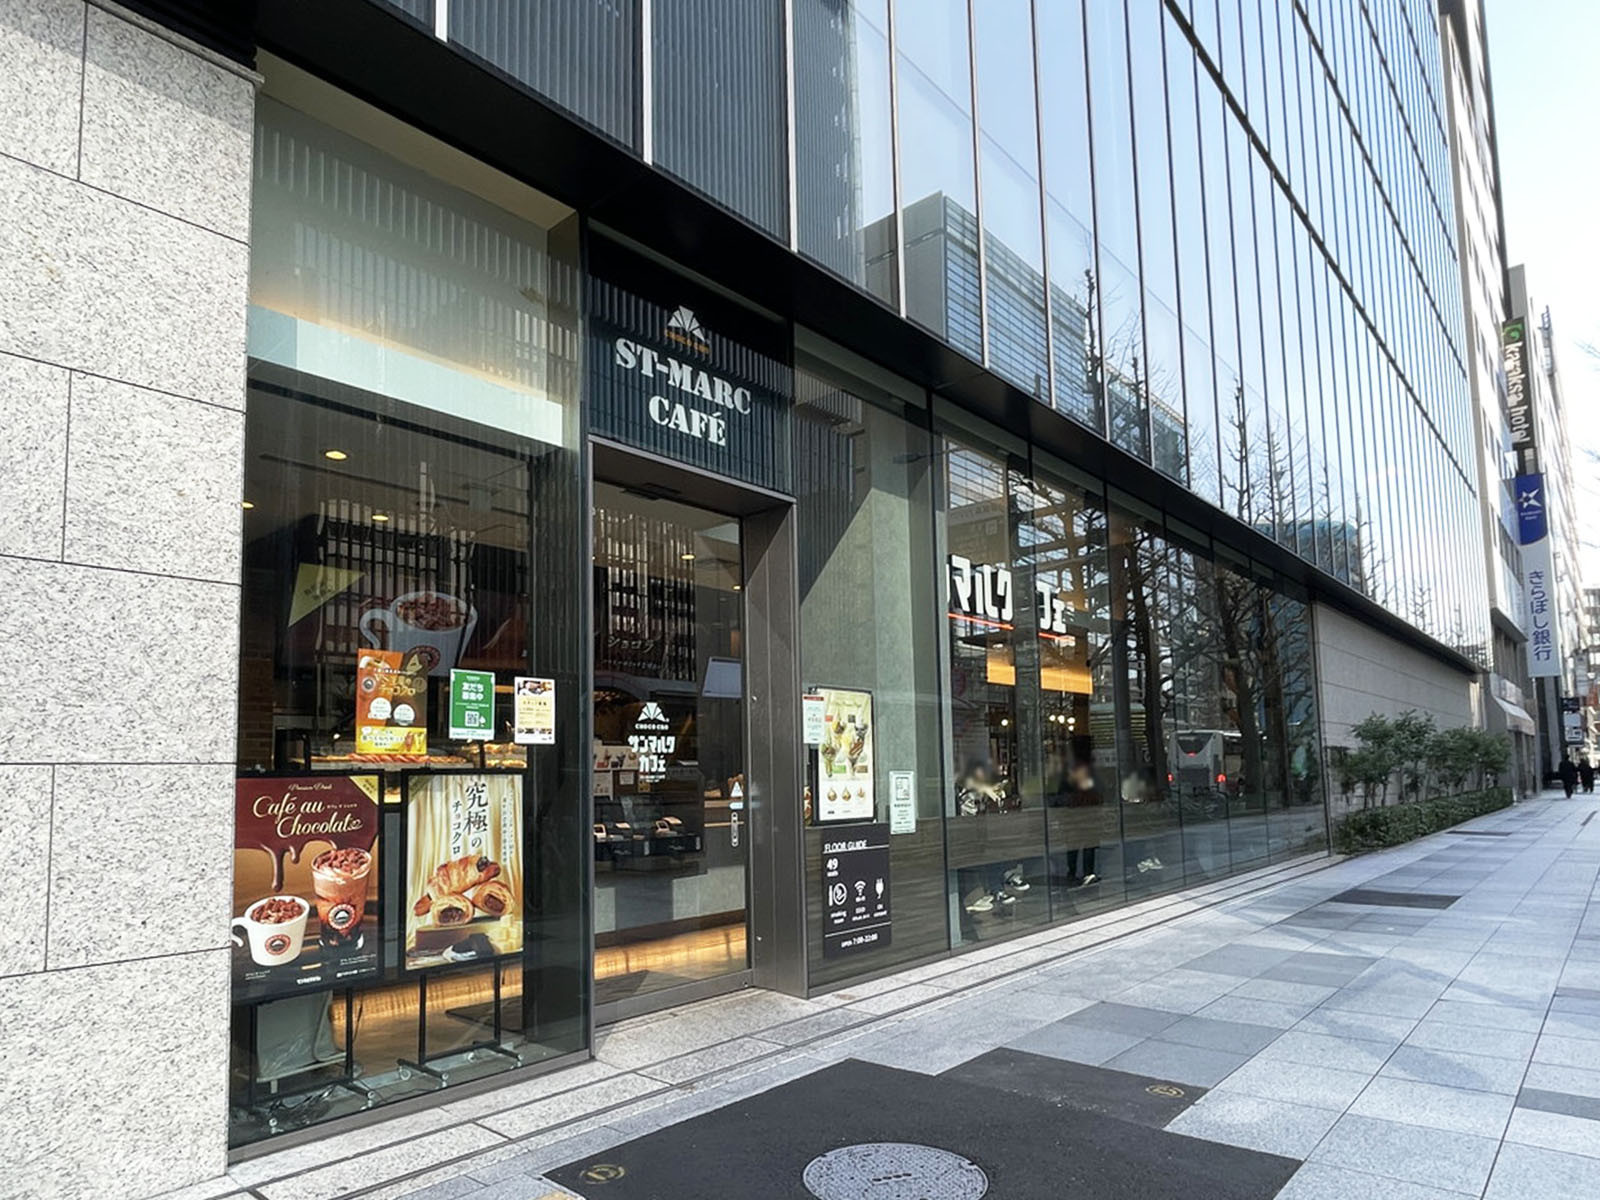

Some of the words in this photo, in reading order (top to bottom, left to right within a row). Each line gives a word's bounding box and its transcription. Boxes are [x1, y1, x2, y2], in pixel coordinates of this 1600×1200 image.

[616, 338, 751, 415] ST-MARC
[649, 395, 726, 446] CAFÉ
[1510, 405, 1531, 443] hotel
[627, 735, 675, 753] サンマルク
[639, 755, 666, 772] カフェ
[253, 792, 298, 823] Café
[300, 800, 325, 813] au
[277, 811, 355, 838] Chocolat
[463, 781, 488, 848] 究極の
[452, 800, 462, 855] チョコクロ
[826, 858, 839, 870] 49
